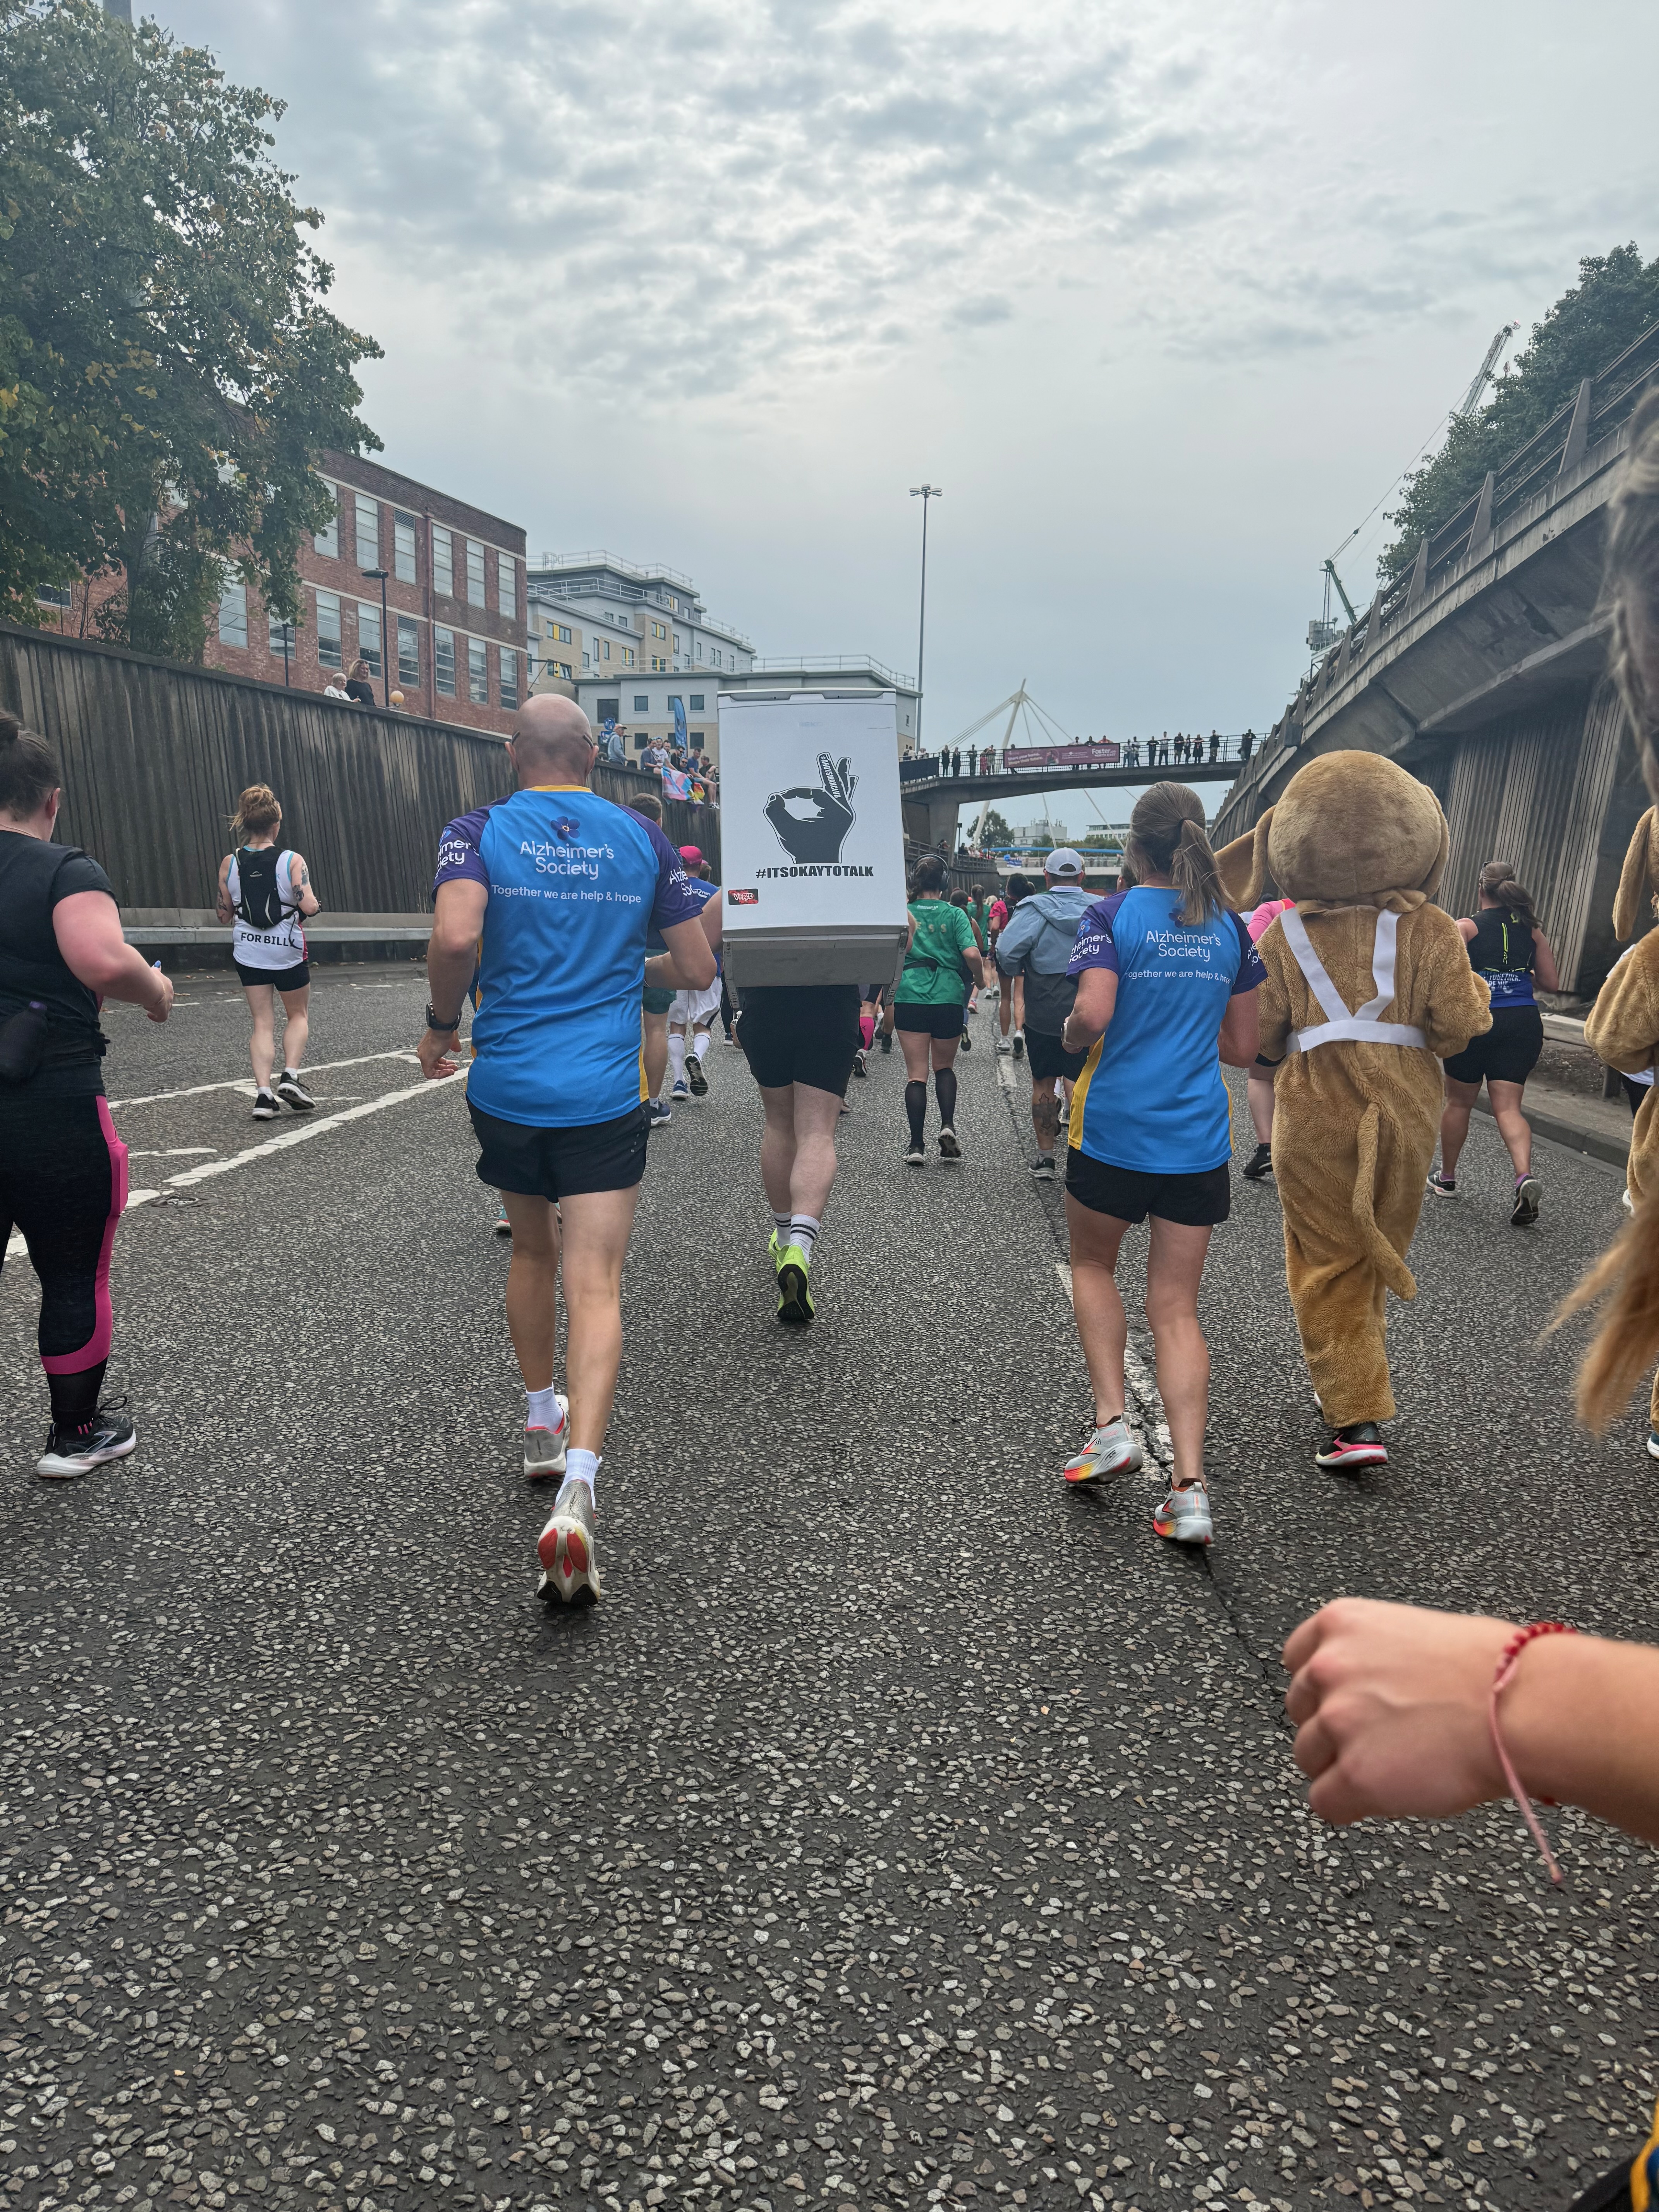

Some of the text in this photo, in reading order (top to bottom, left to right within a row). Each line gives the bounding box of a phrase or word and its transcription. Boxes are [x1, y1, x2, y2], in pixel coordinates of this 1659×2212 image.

[820, 756, 841, 798] #ANDYSMANCLUB
[520, 840, 614, 859] Alzheimer's
[536, 857, 599, 880] Society
[756, 866, 874, 878] #ITSOKAYTOTALK
[491, 885, 541, 897] Together
[560, 891, 578, 900] are
[581, 890, 604, 902] help
[606, 891, 613, 901] &
[615, 892, 641, 904] hope
[241, 933, 261, 943] FOR
[1146, 930, 1221, 946] Alzheimer's
[1158, 943, 1210, 962] Society
[1196, 970, 1213, 981] help
[1214, 972, 1219, 981] &
